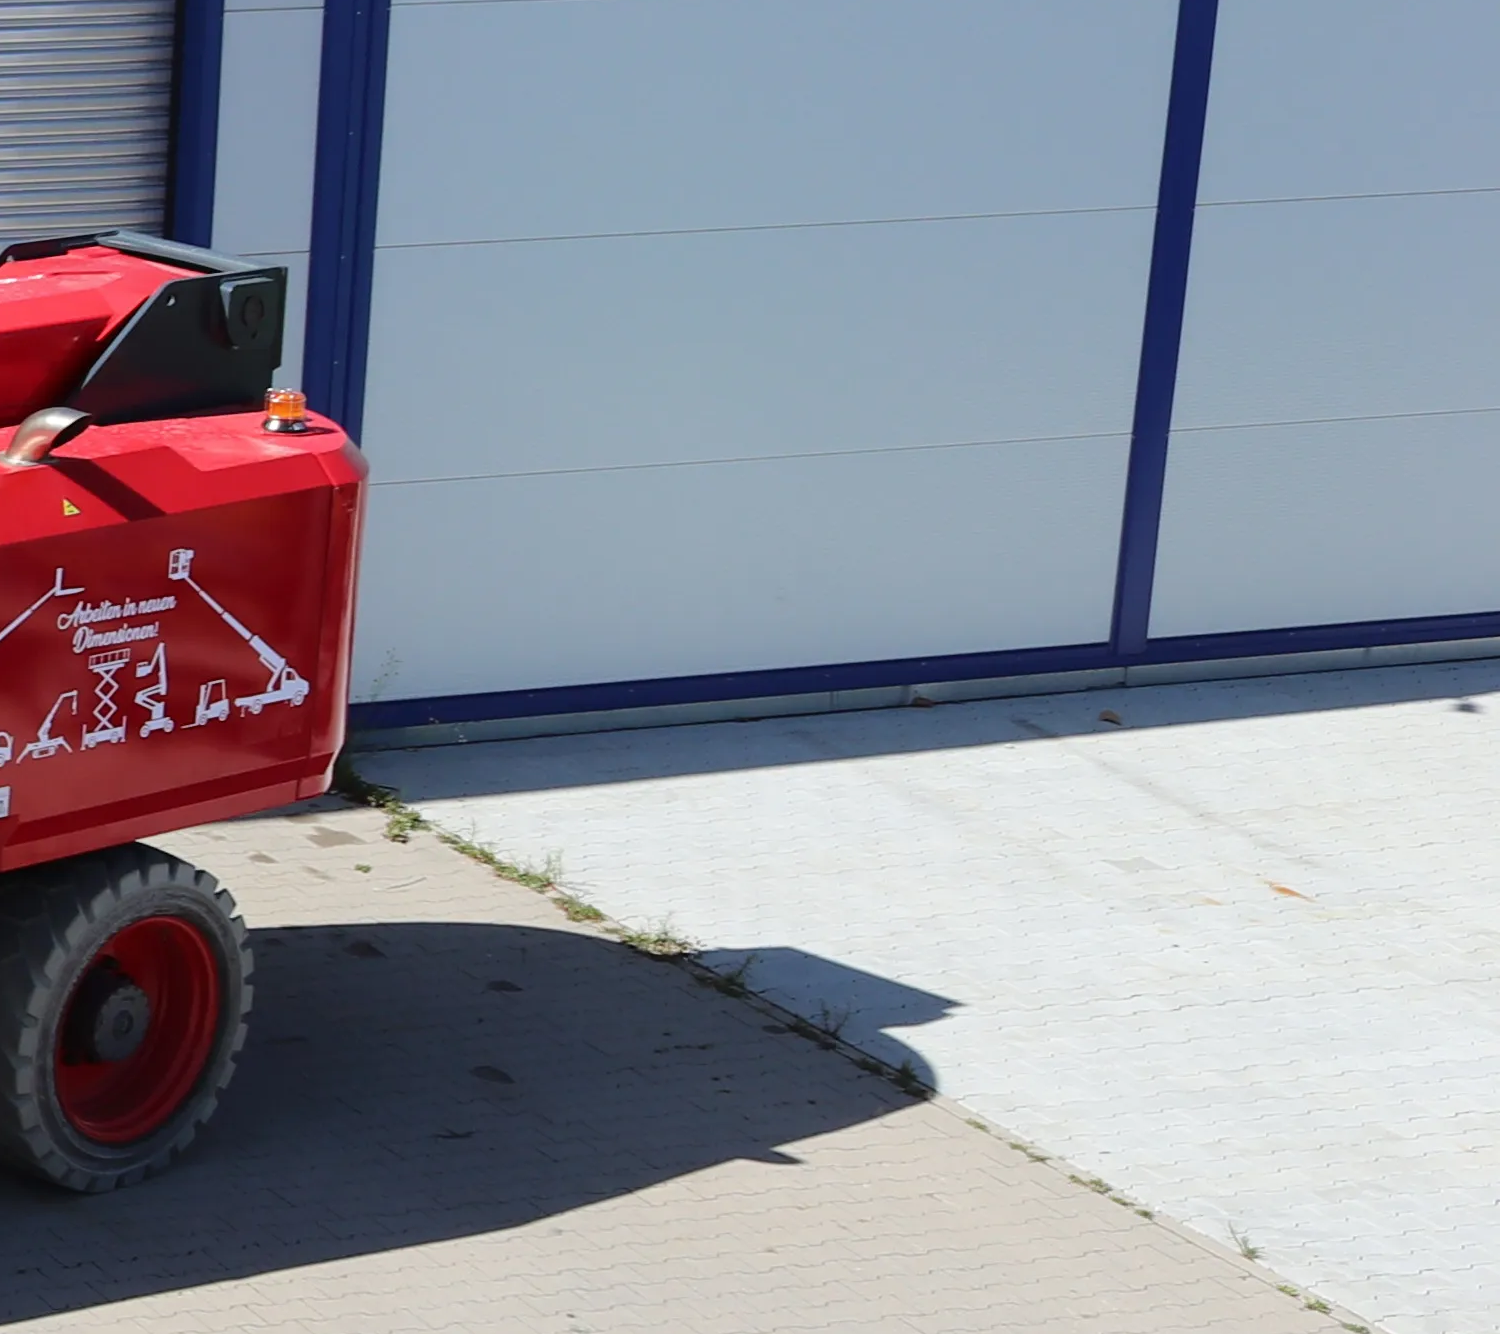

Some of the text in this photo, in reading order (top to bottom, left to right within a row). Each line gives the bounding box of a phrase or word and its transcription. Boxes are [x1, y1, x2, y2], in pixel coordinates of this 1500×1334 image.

[57, 595, 177, 630] Arbeiten in neuen
[72, 621, 159, 654] Dimensionen!
